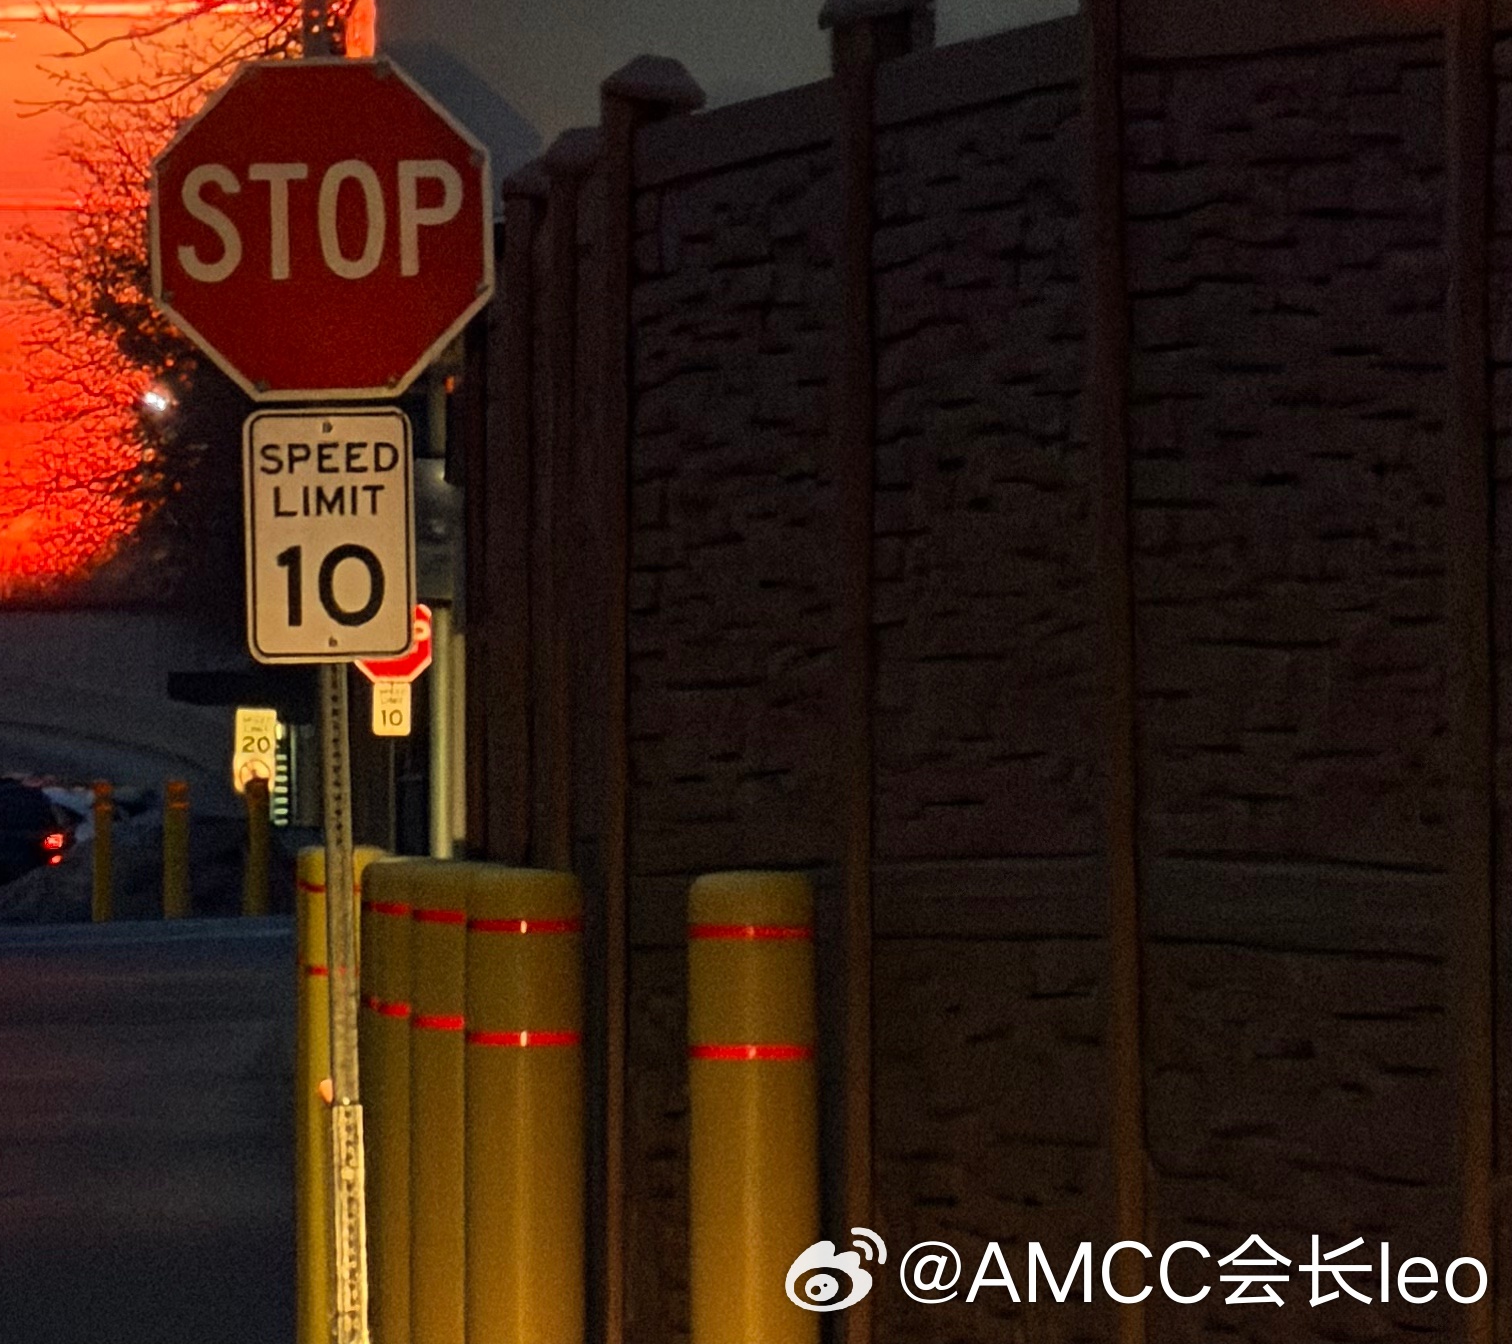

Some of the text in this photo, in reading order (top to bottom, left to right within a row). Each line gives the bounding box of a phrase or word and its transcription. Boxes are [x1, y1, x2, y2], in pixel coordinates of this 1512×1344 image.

[177, 158, 464, 283] STOP
[259, 441, 400, 475] SPEED
[273, 484, 385, 518] LIMIT
[276, 543, 386, 628] 10
[381, 709, 403, 727] 10
[242, 735, 271, 754] 20
